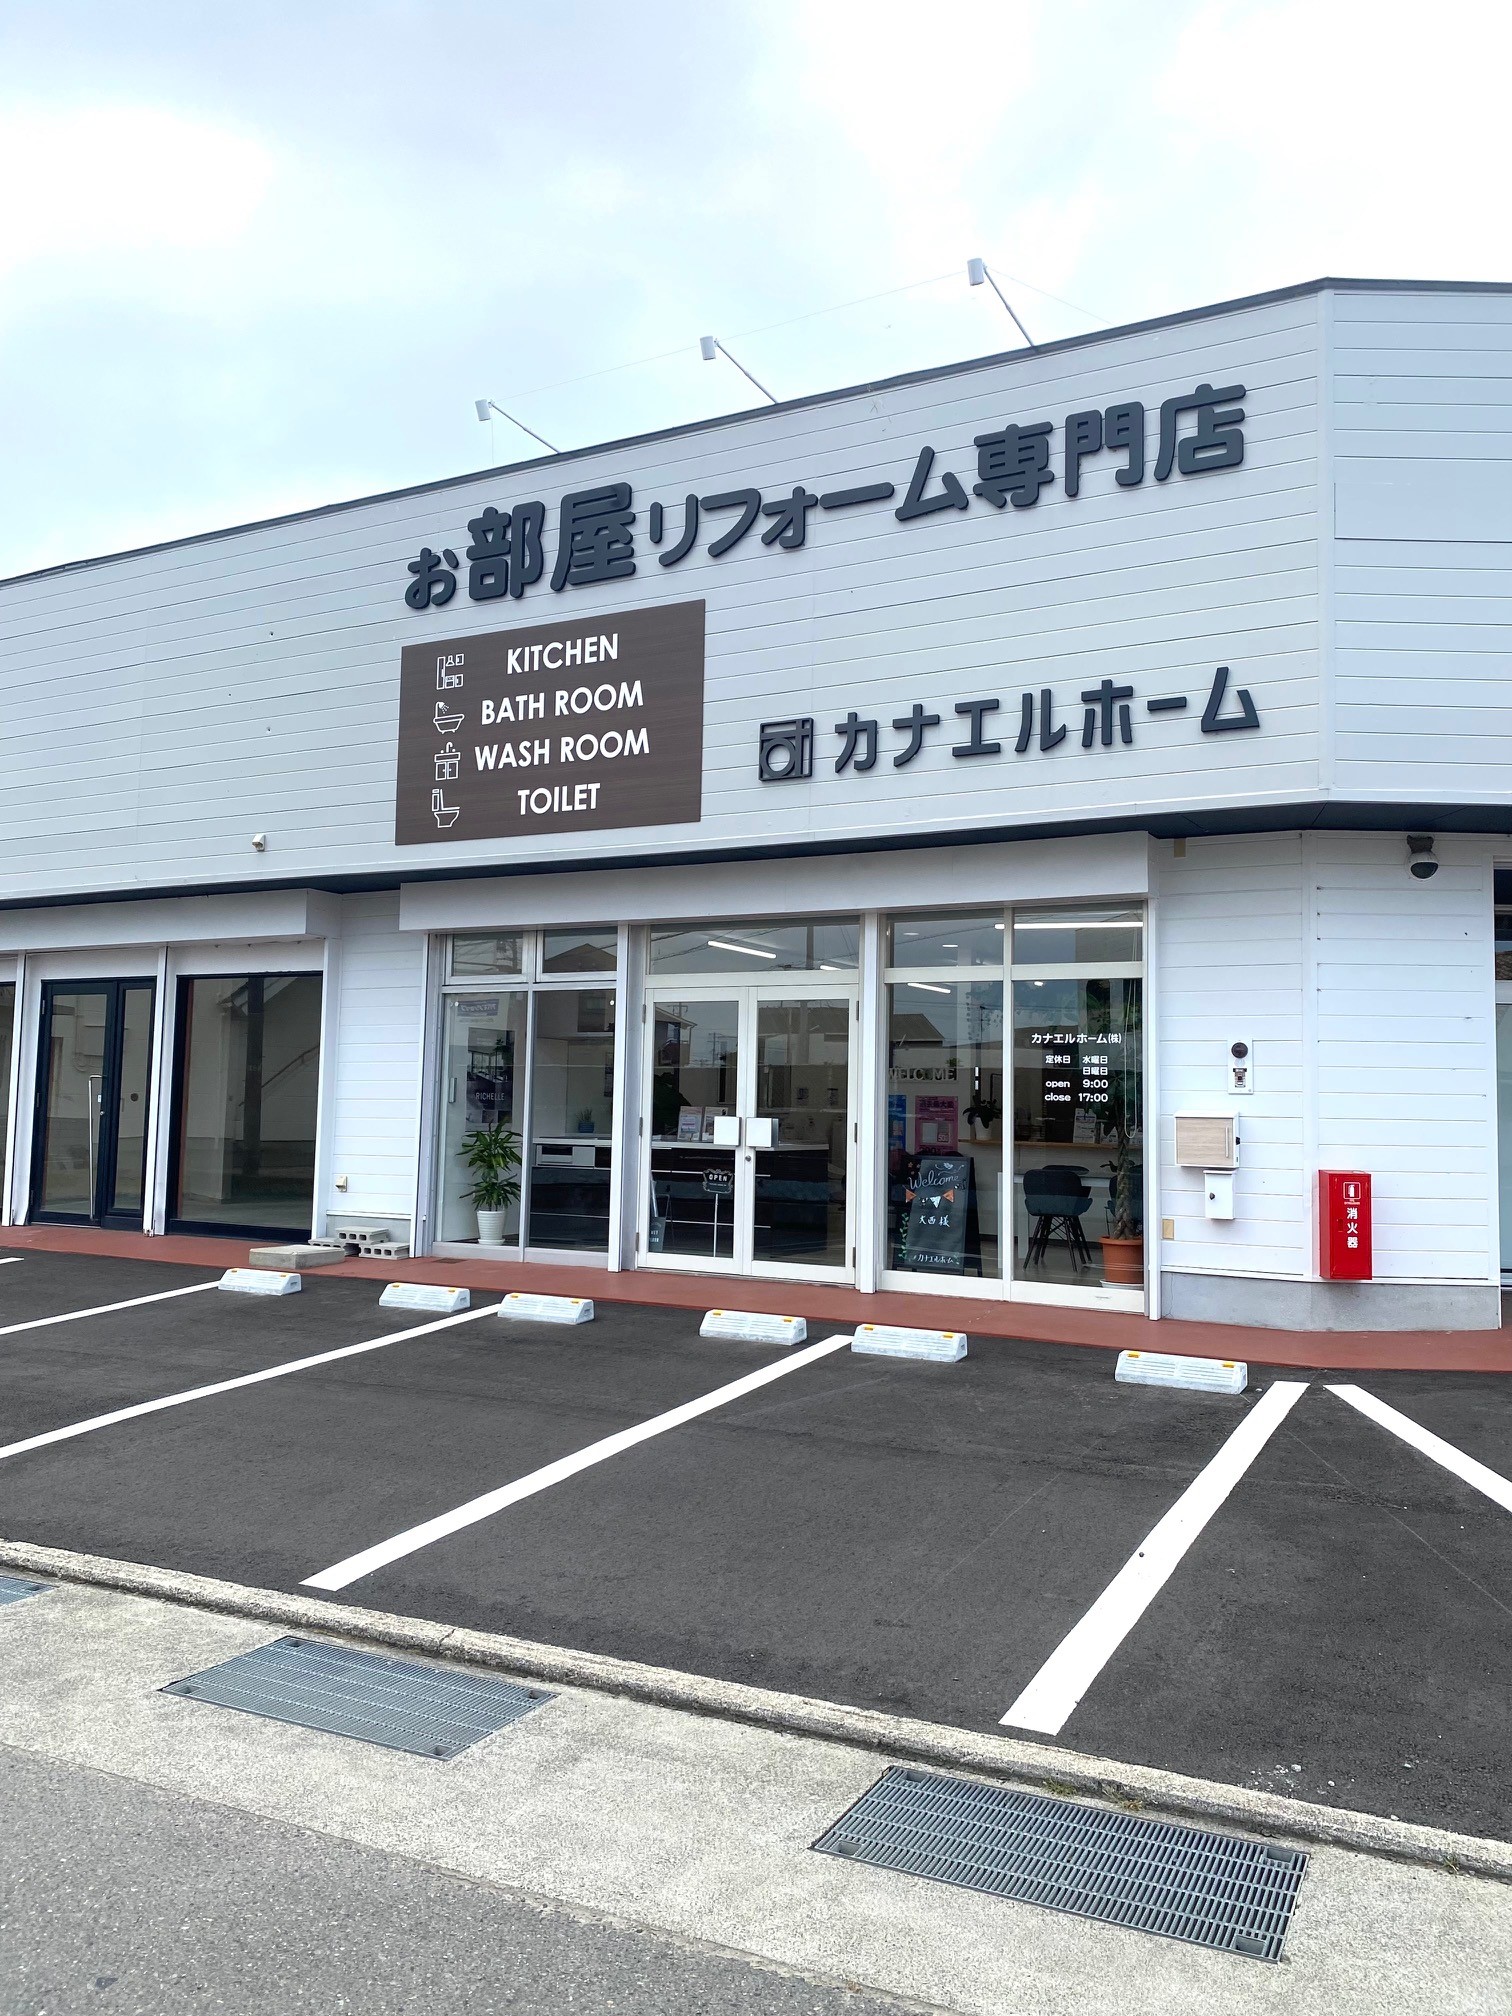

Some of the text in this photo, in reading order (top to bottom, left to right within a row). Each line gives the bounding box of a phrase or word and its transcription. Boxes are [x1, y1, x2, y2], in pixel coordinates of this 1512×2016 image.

[404, 383, 1247, 610] お部屋リフォーム専門店
[506, 632, 619, 675] KITCHEN
[481, 679, 644, 726] BATH ROOM
[834, 666, 1260, 773] カナエルホーム
[474, 727, 650, 772] WASH ROOM
[517, 782, 601, 816] TOILET
[1045, 1055, 1108, 1064] 定休日 水曜日
[1082, 1066, 1108, 1076] 日曜日
[475, 1091, 505, 1101] RICHELLE
[1045, 1079, 1109, 1088] open 9:00
[1044, 1093, 1109, 1102] close 17:00
[708, 1173, 728, 1182] OPEN
[908, 1169, 959, 1190] Welcome
[1346, 1207, 1359, 1249] 消火器
